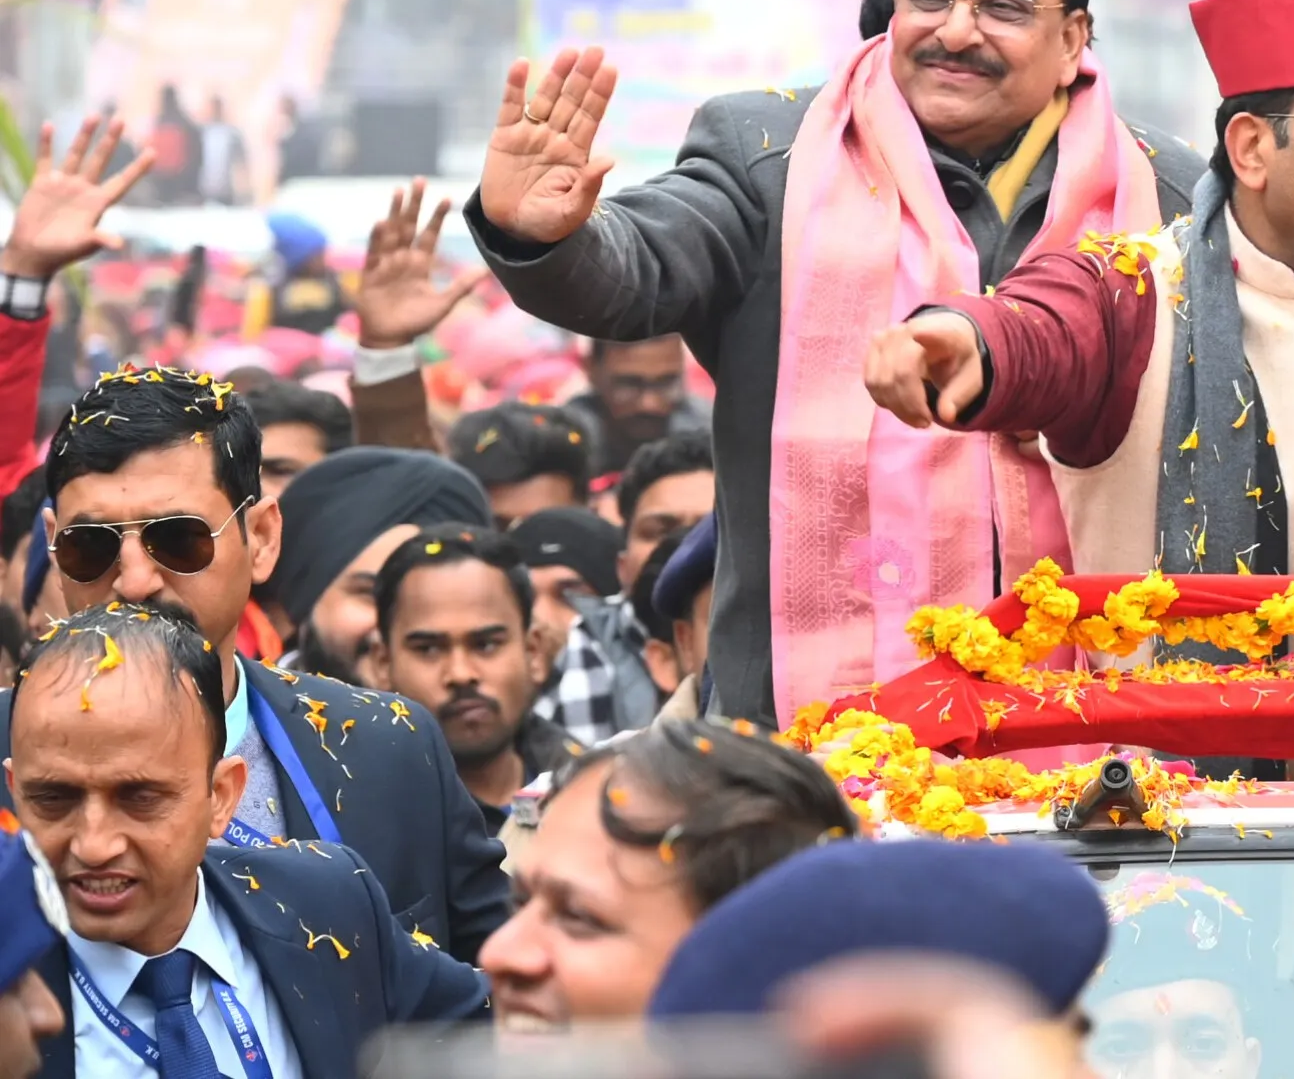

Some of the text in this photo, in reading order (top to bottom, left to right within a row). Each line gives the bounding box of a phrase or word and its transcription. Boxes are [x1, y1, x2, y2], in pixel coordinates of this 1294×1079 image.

[83, 982, 109, 1017] SECURITY
[107, 1012, 121, 1027] CM
[241, 1033, 254, 1049] CM
